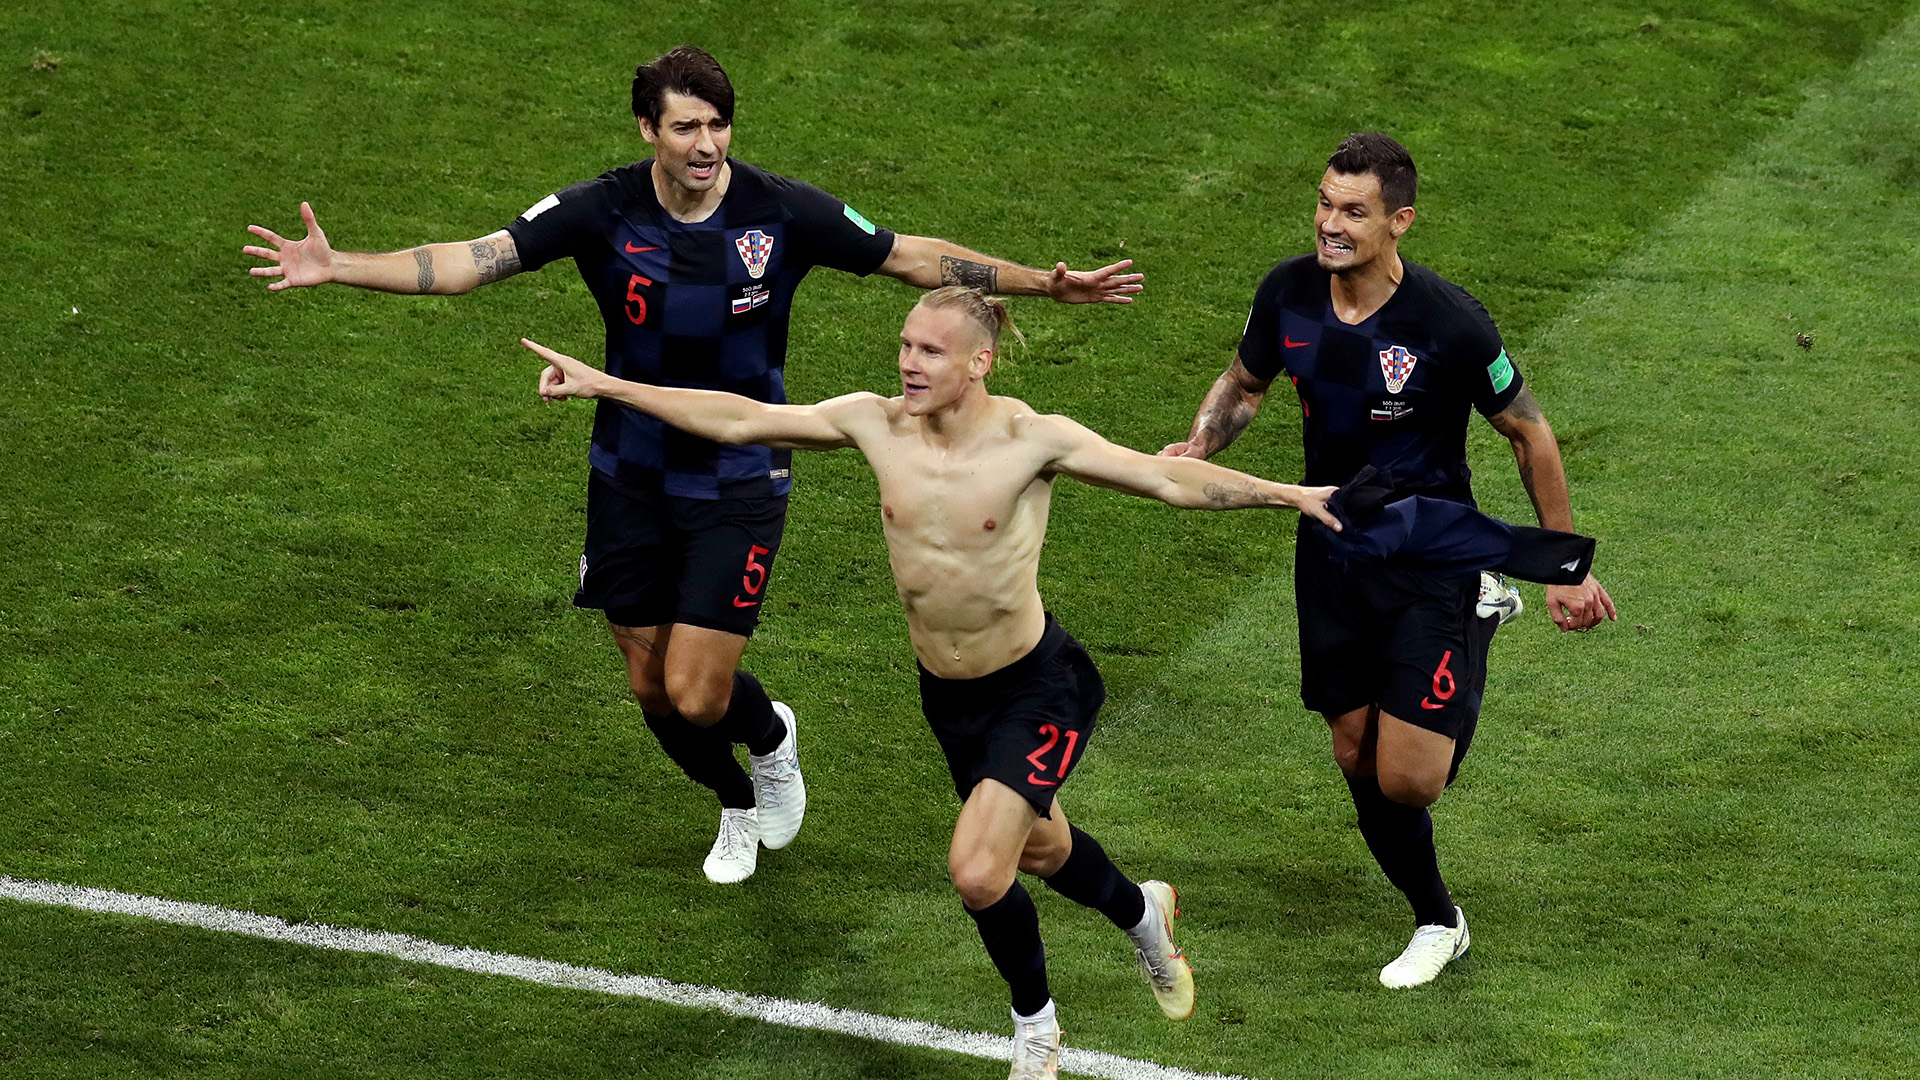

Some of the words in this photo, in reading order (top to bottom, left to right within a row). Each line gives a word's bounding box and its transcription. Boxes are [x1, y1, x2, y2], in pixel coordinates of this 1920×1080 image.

[625, 273, 653, 325] 5
[743, 544, 770, 595] 5
[1432, 650, 1456, 700] 6
[1026, 723, 1079, 779] 21
